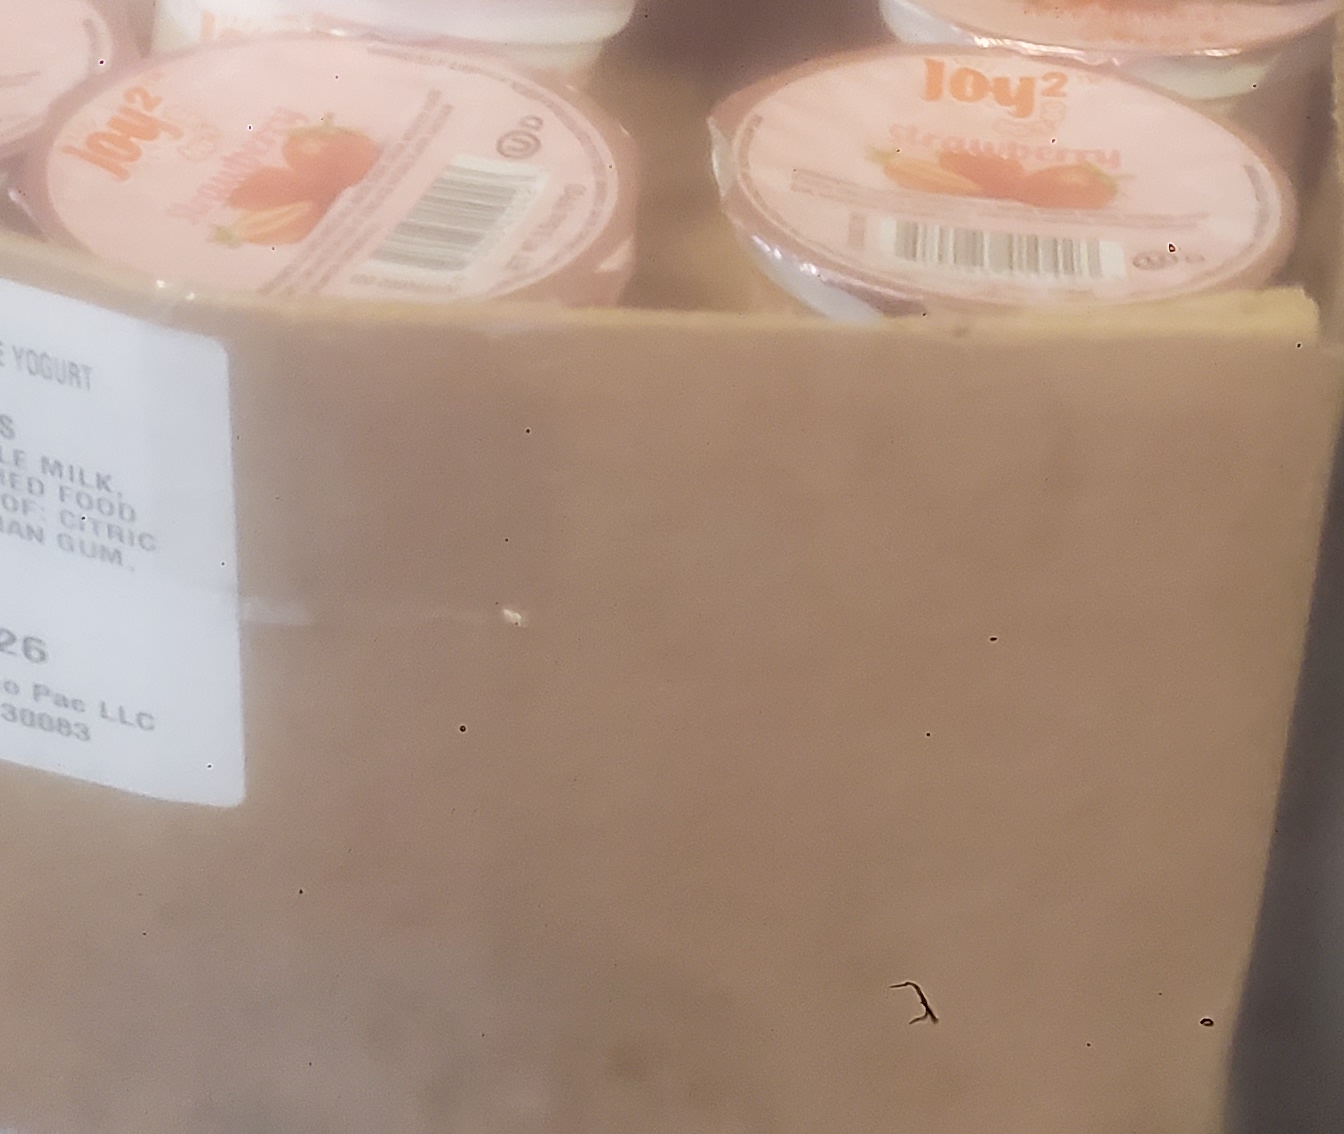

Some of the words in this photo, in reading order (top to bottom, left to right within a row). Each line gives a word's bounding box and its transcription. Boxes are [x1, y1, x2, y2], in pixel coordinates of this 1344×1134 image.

[11, 342, 93, 392] YOGURT
[41, 454, 123, 500] MILK,
[58, 483, 137, 524] FOOD
[57, 530, 136, 572] GUM,
[60, 507, 157, 553] CITRIC
[1, 702, 92, 743] 30083
[31, 681, 86, 713] Pac
[99, 700, 155, 732] LLC
